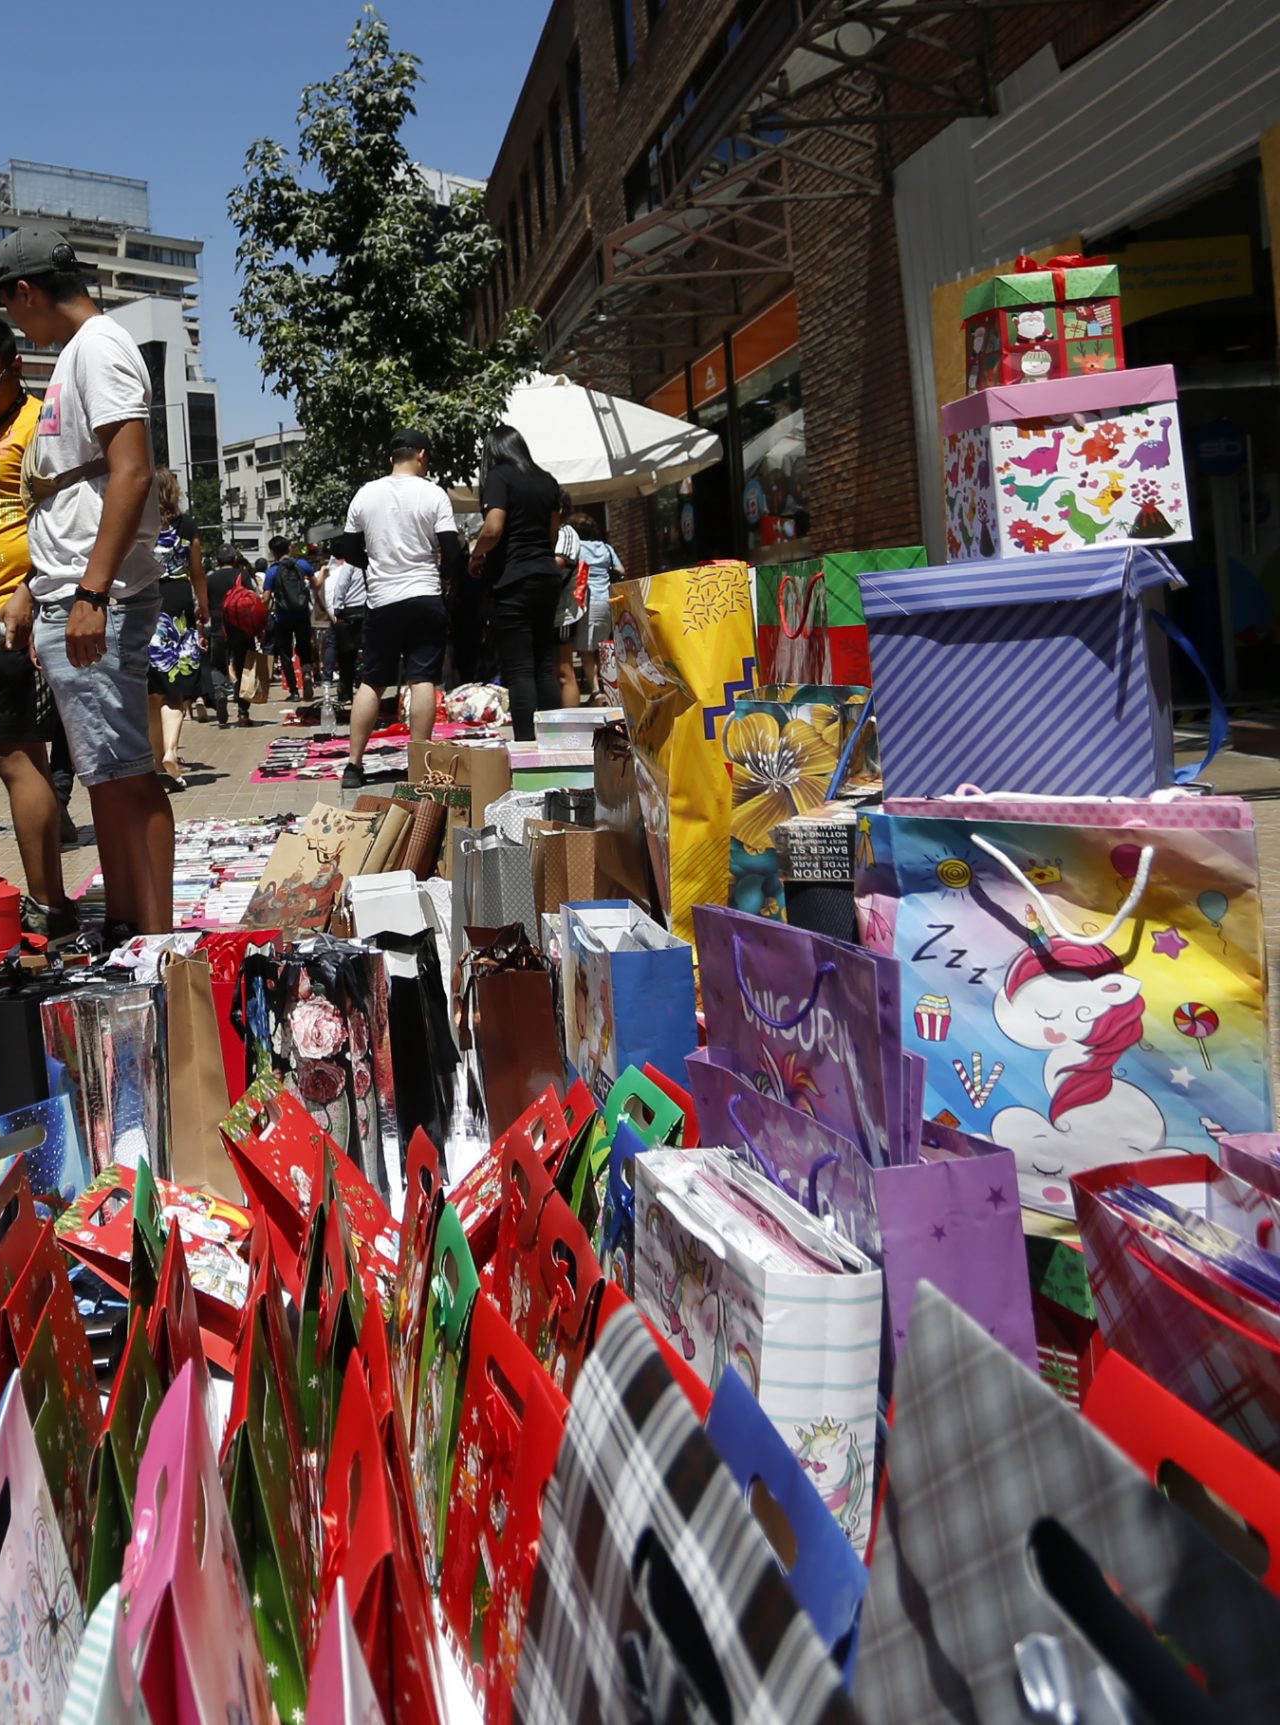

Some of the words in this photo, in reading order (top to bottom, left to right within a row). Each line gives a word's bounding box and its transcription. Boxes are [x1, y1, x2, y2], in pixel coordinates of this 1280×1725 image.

[792, 846, 806, 854] ST
[810, 846, 848, 854] BAKER
[793, 869, 850, 879] LONDON
[740, 976, 856, 1070] UNICORN
